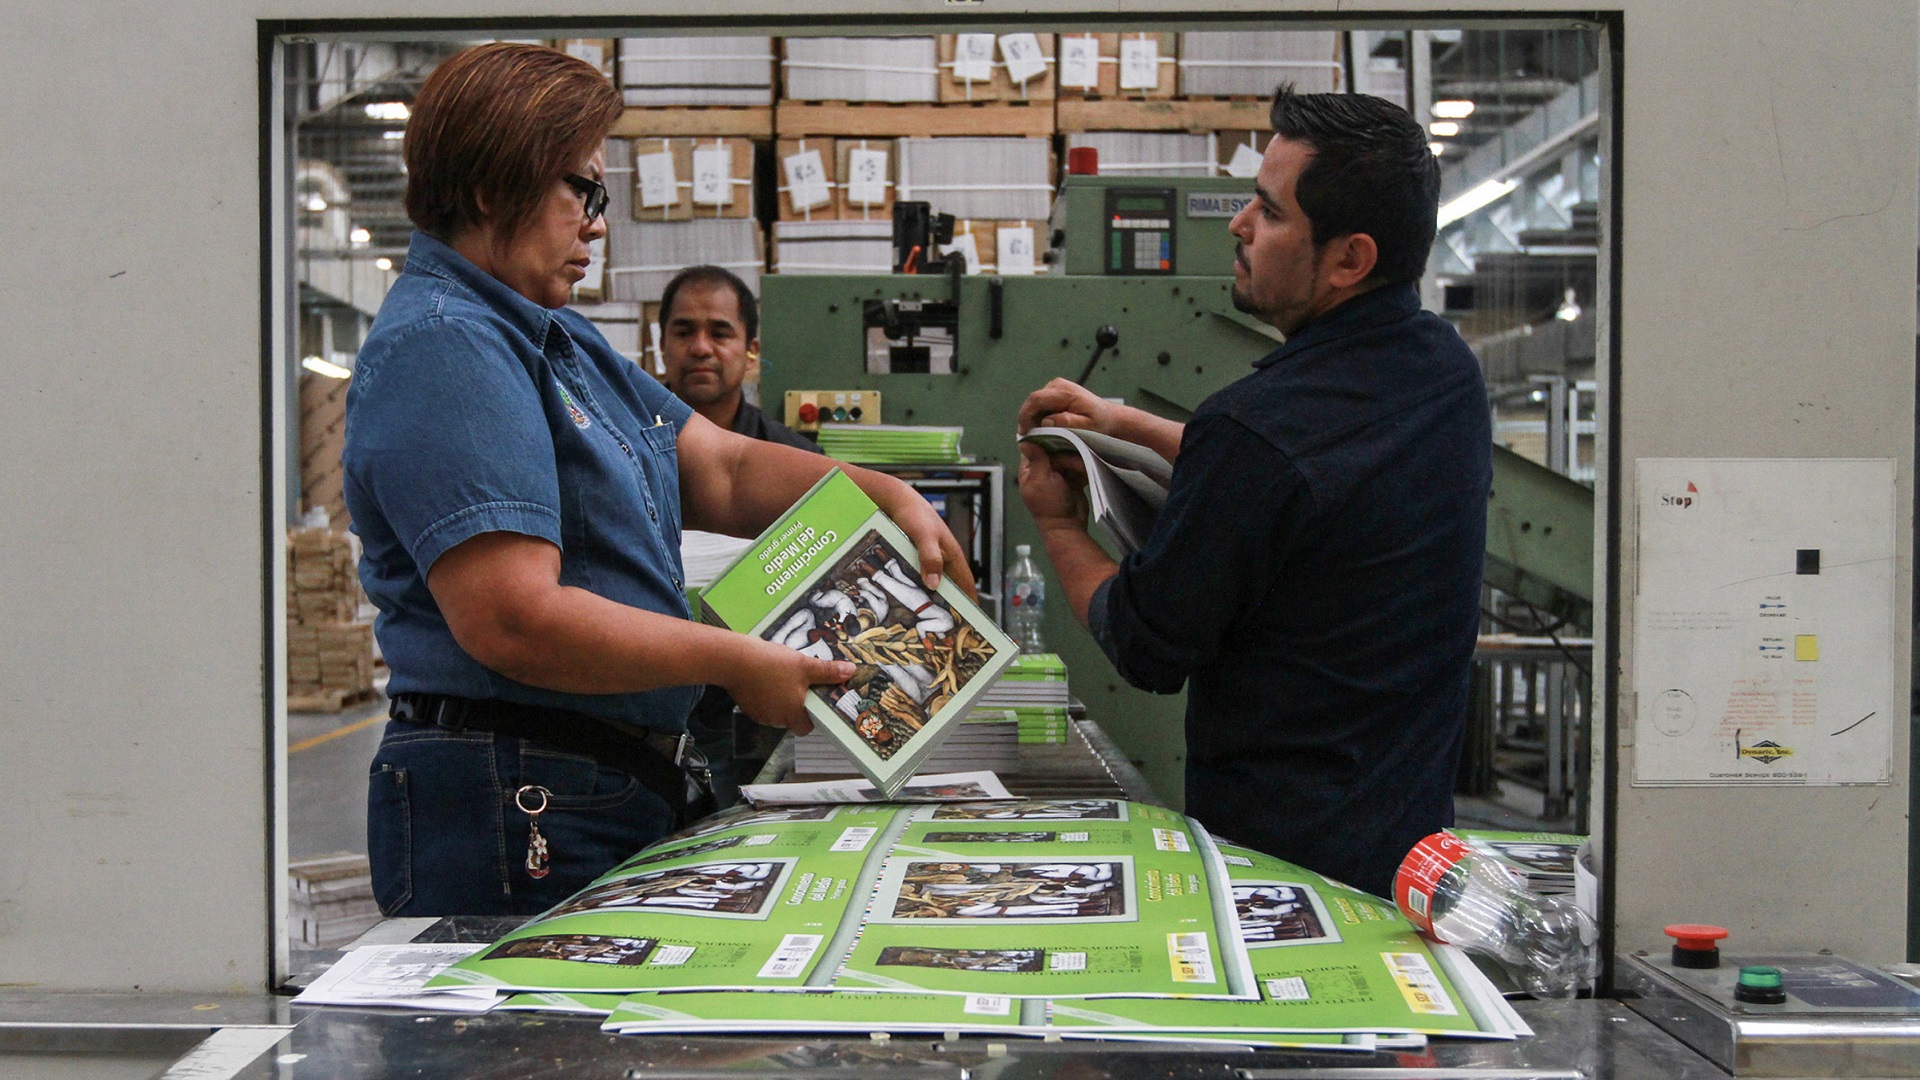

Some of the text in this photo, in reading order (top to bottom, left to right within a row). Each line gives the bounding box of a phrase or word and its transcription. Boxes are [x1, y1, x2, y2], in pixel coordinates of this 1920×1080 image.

[1189, 199, 1220, 212] RIMA
[1660, 494, 1692, 509] Stop
[758, 521, 803, 560] Primer grado
[764, 526, 815, 574] del Medio
[765, 530, 837, 595] Conocimiento
